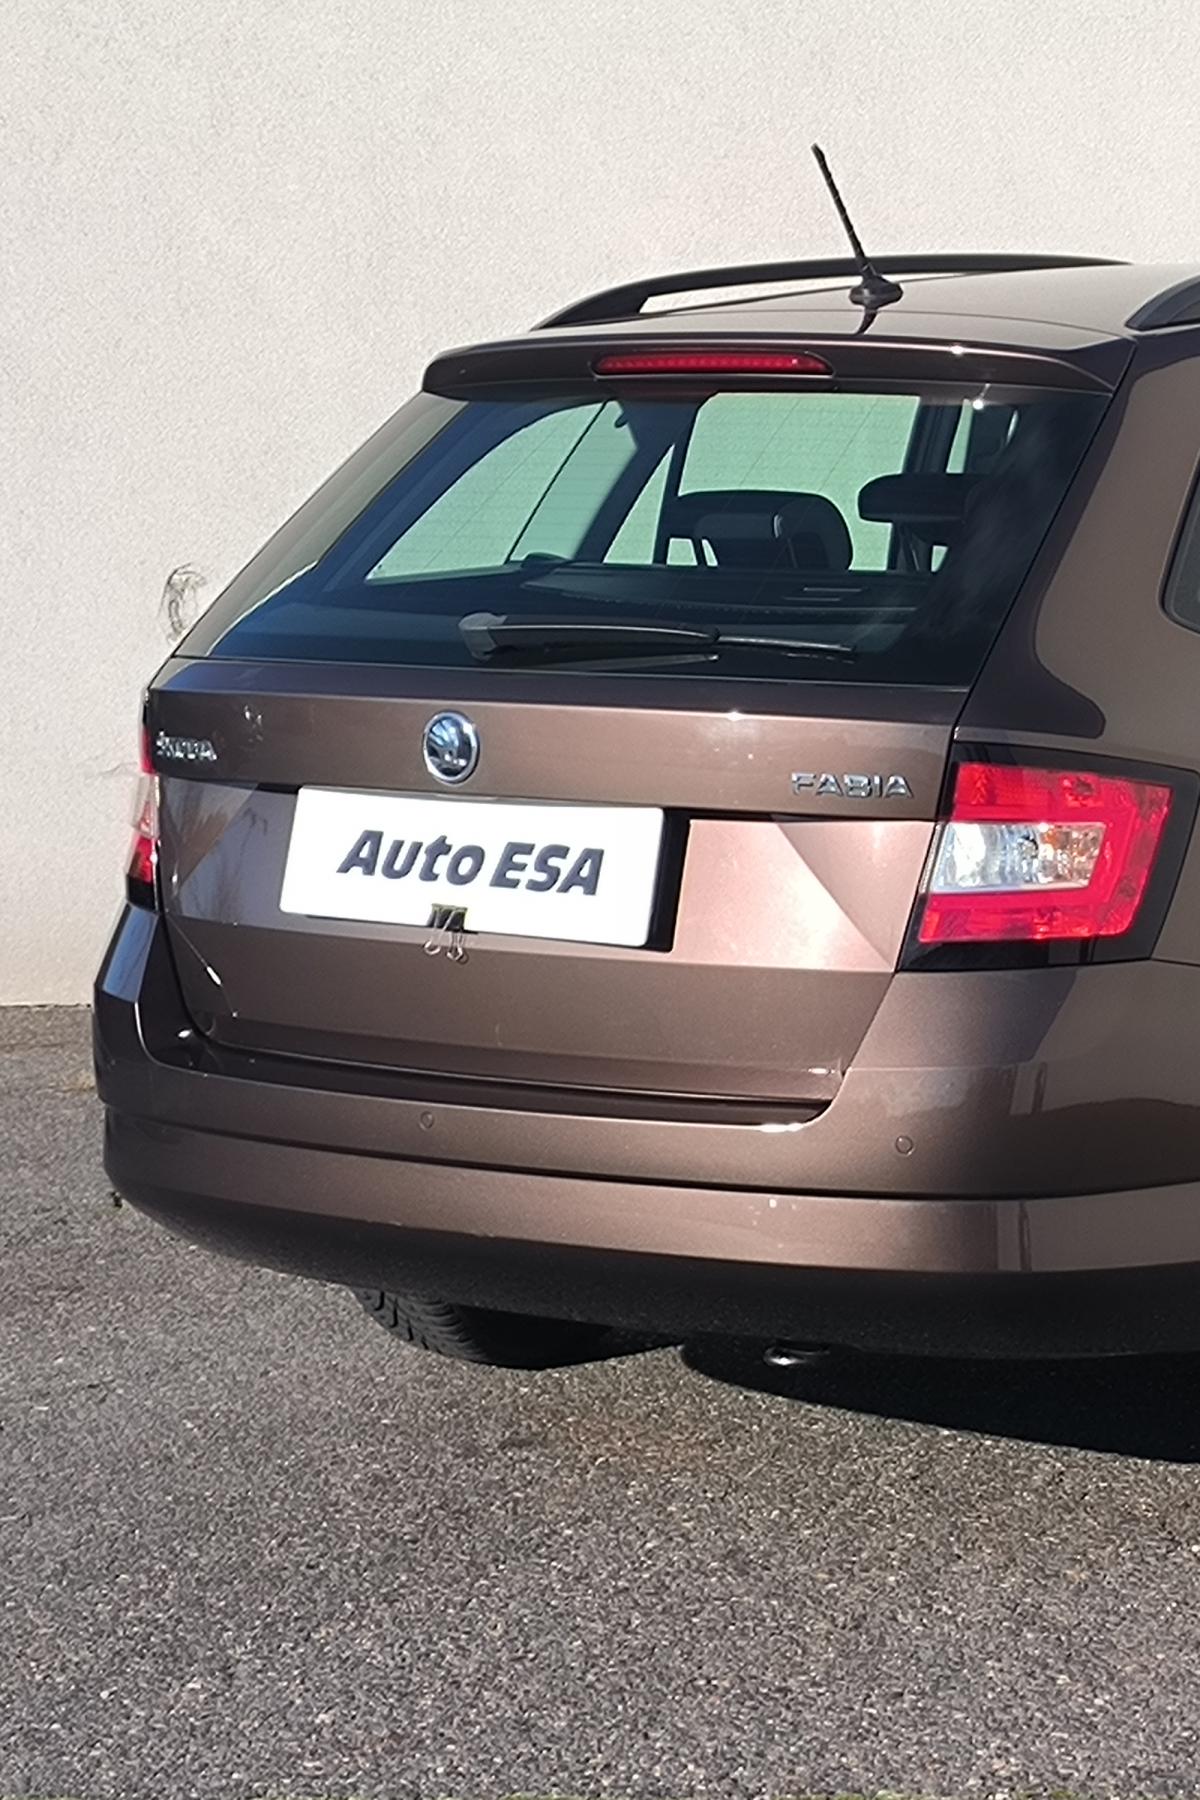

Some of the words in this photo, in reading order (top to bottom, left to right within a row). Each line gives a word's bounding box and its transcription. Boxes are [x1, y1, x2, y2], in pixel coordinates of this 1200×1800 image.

[791, 772, 914, 798] FABIA
[336, 829, 486, 886] Auto
[489, 841, 605, 896] ESA
